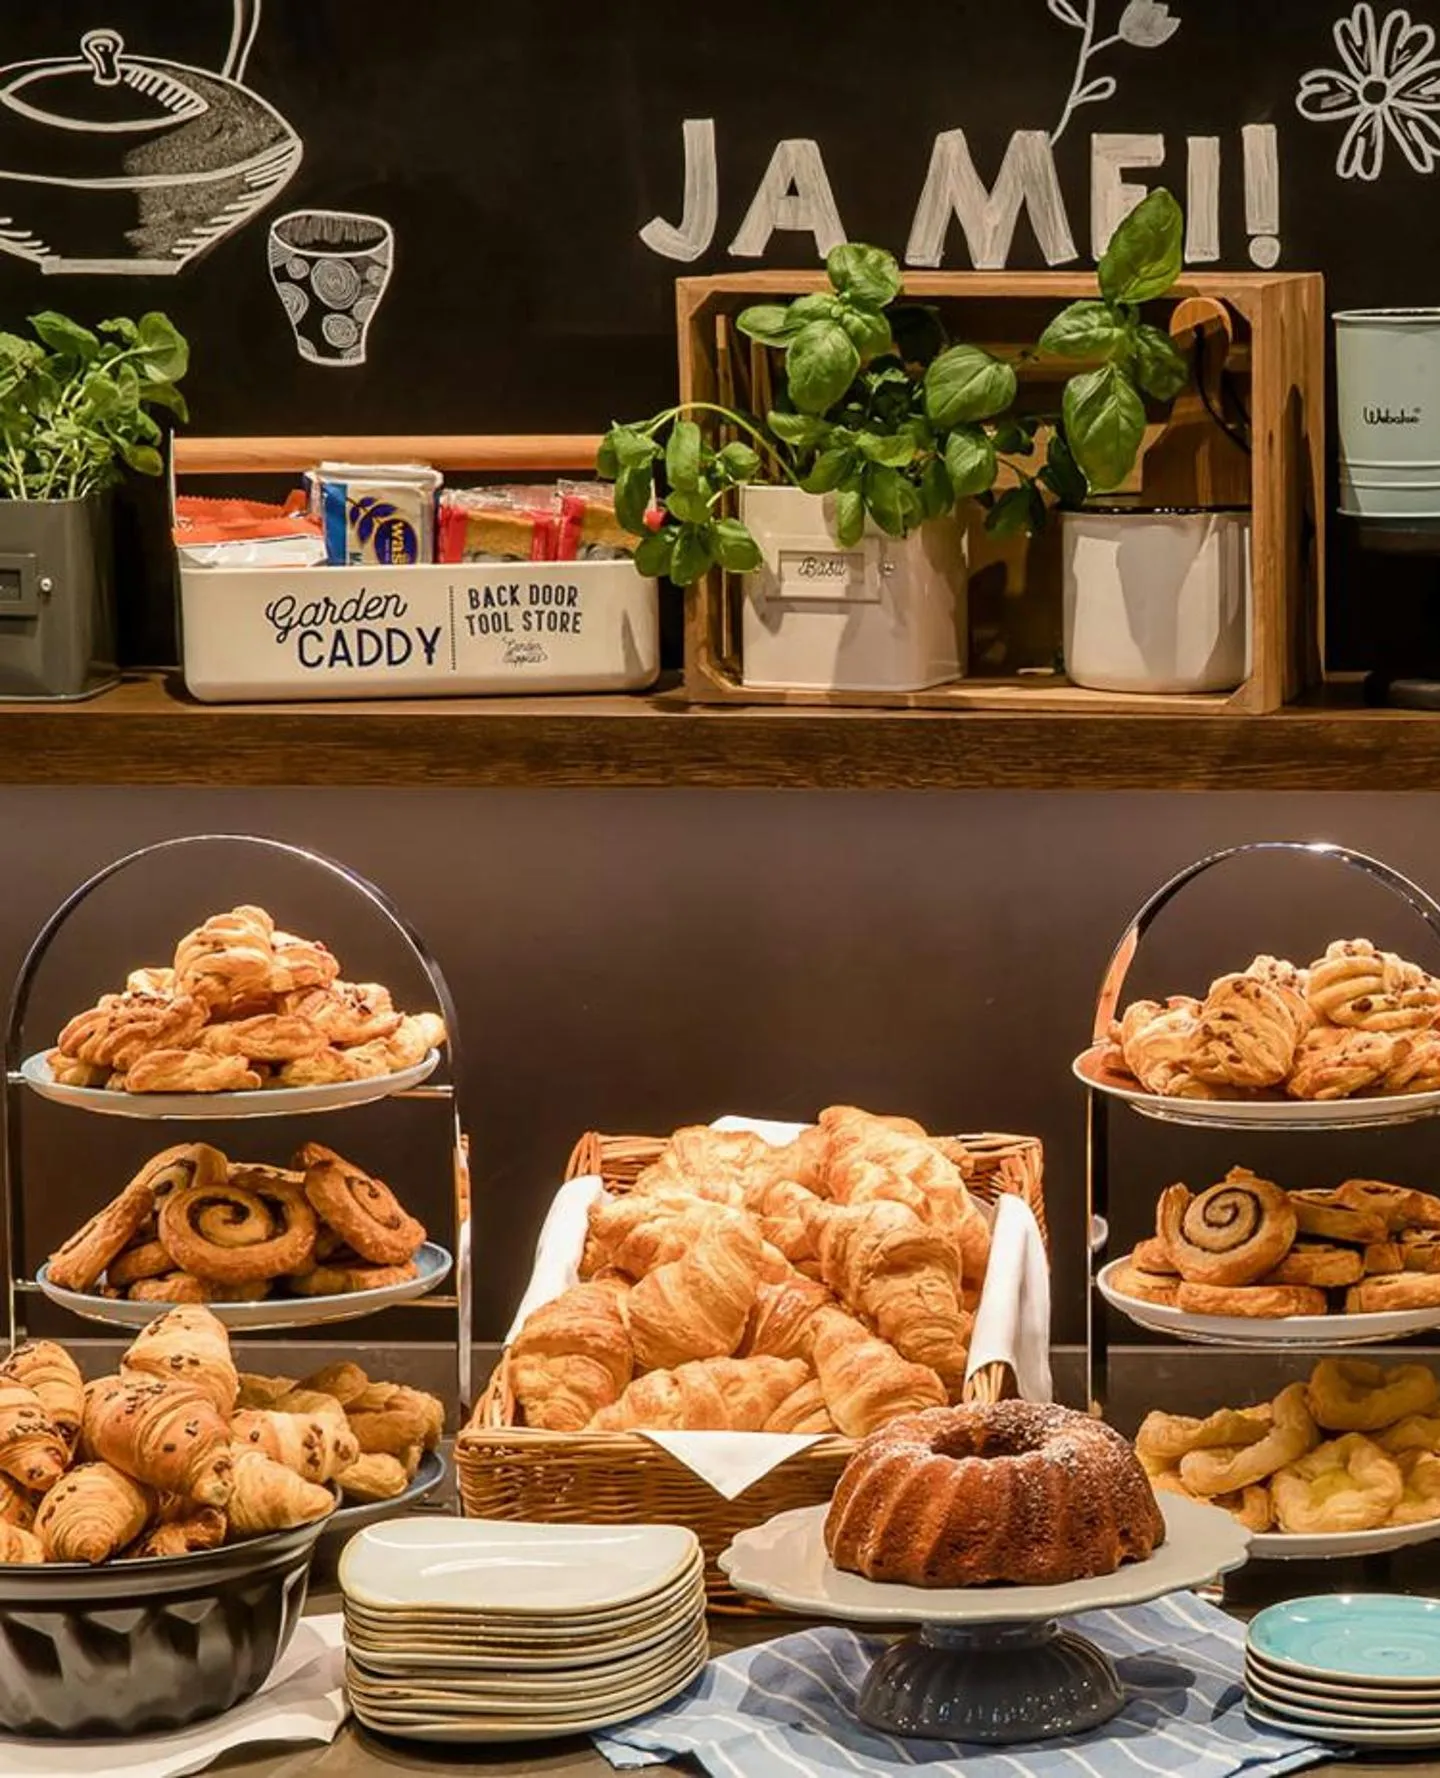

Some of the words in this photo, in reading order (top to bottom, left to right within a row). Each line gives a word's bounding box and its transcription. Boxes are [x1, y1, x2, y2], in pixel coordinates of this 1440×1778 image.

[638, 118, 847, 262] JA
[265, 587, 408, 644] Garden
[468, 584, 520, 610] BACK
[529, 584, 578, 608] DOOR
[465, 612, 514, 636] TOOL
[522, 610, 582, 634] STORE
[298, 626, 442, 669] CADDY
